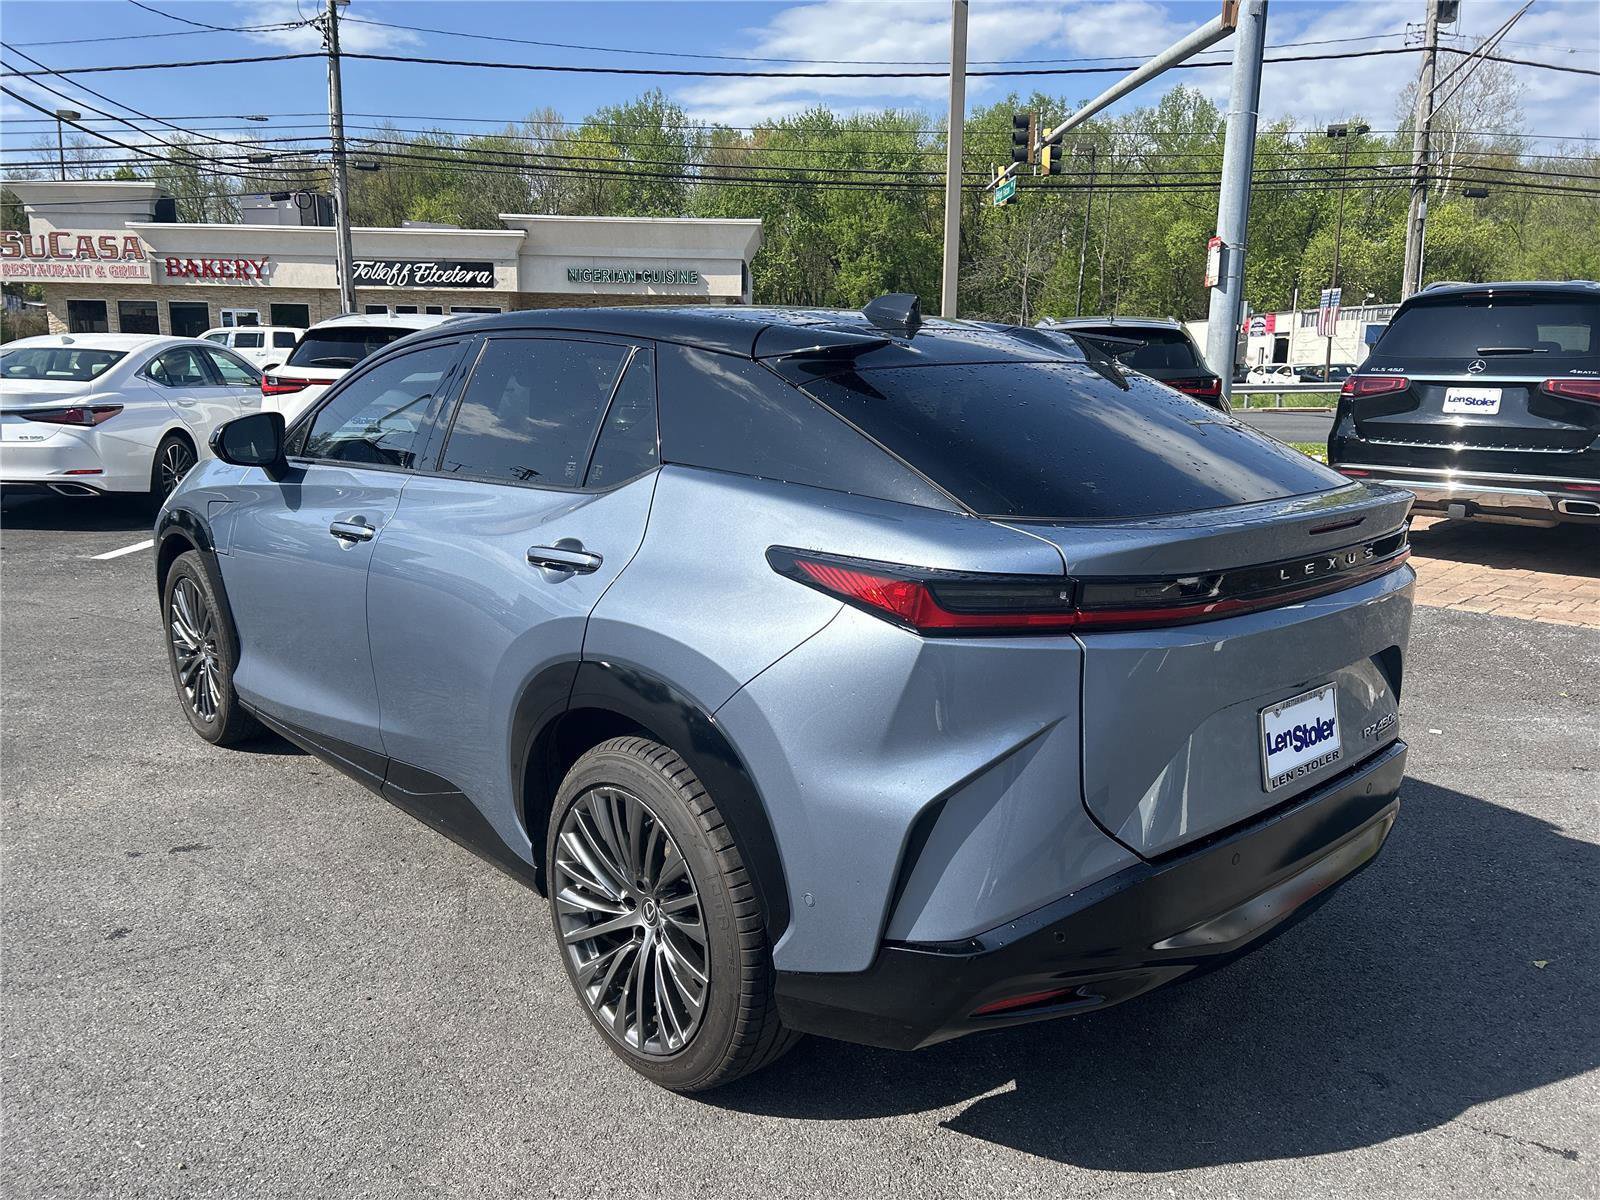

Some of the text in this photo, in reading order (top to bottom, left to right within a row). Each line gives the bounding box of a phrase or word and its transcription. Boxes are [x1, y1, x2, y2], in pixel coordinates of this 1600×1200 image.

[2, 263, 149, 279] RESTAURANT & GRILL
[165, 256, 269, 280] BAKERY
[352, 260, 492, 286] Tolloff Etcetera
[567, 268, 698, 285] NIGERIAN CUISINE
[1280, 547, 1374, 580] LEXUS
[1272, 750, 1340, 789] LEN STOLER
